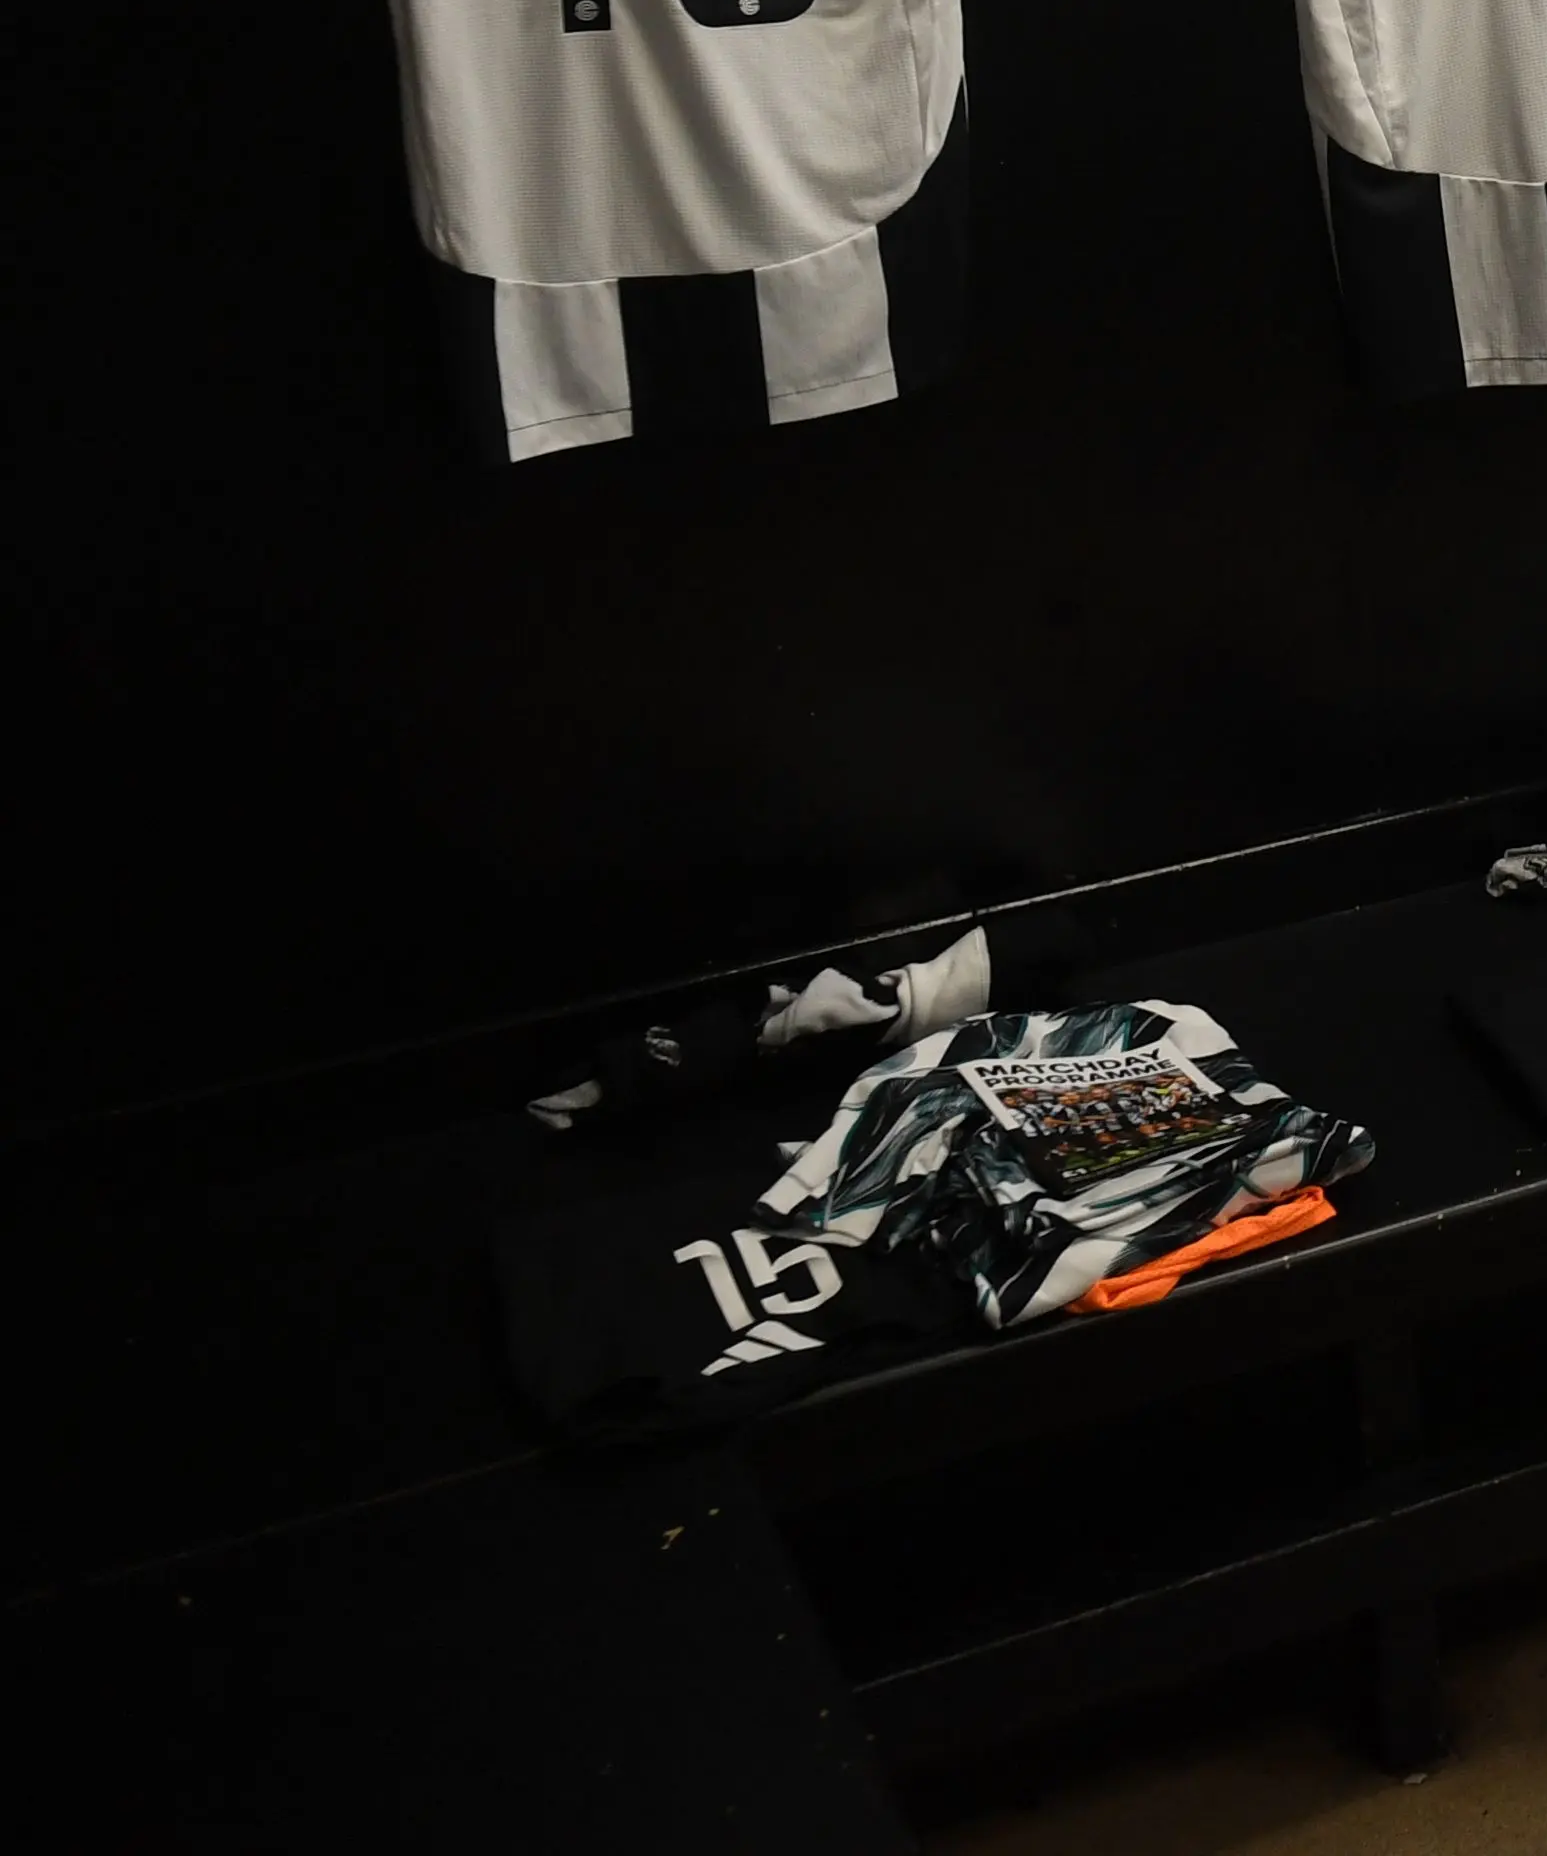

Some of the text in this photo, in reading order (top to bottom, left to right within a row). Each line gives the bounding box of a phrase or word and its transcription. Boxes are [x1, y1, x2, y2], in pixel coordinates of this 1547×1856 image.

[974, 1048, 1161, 1078] MATCHDAY
[983, 1058, 1175, 1088] PROGRAMME
[674, 1227, 843, 1332] 15
